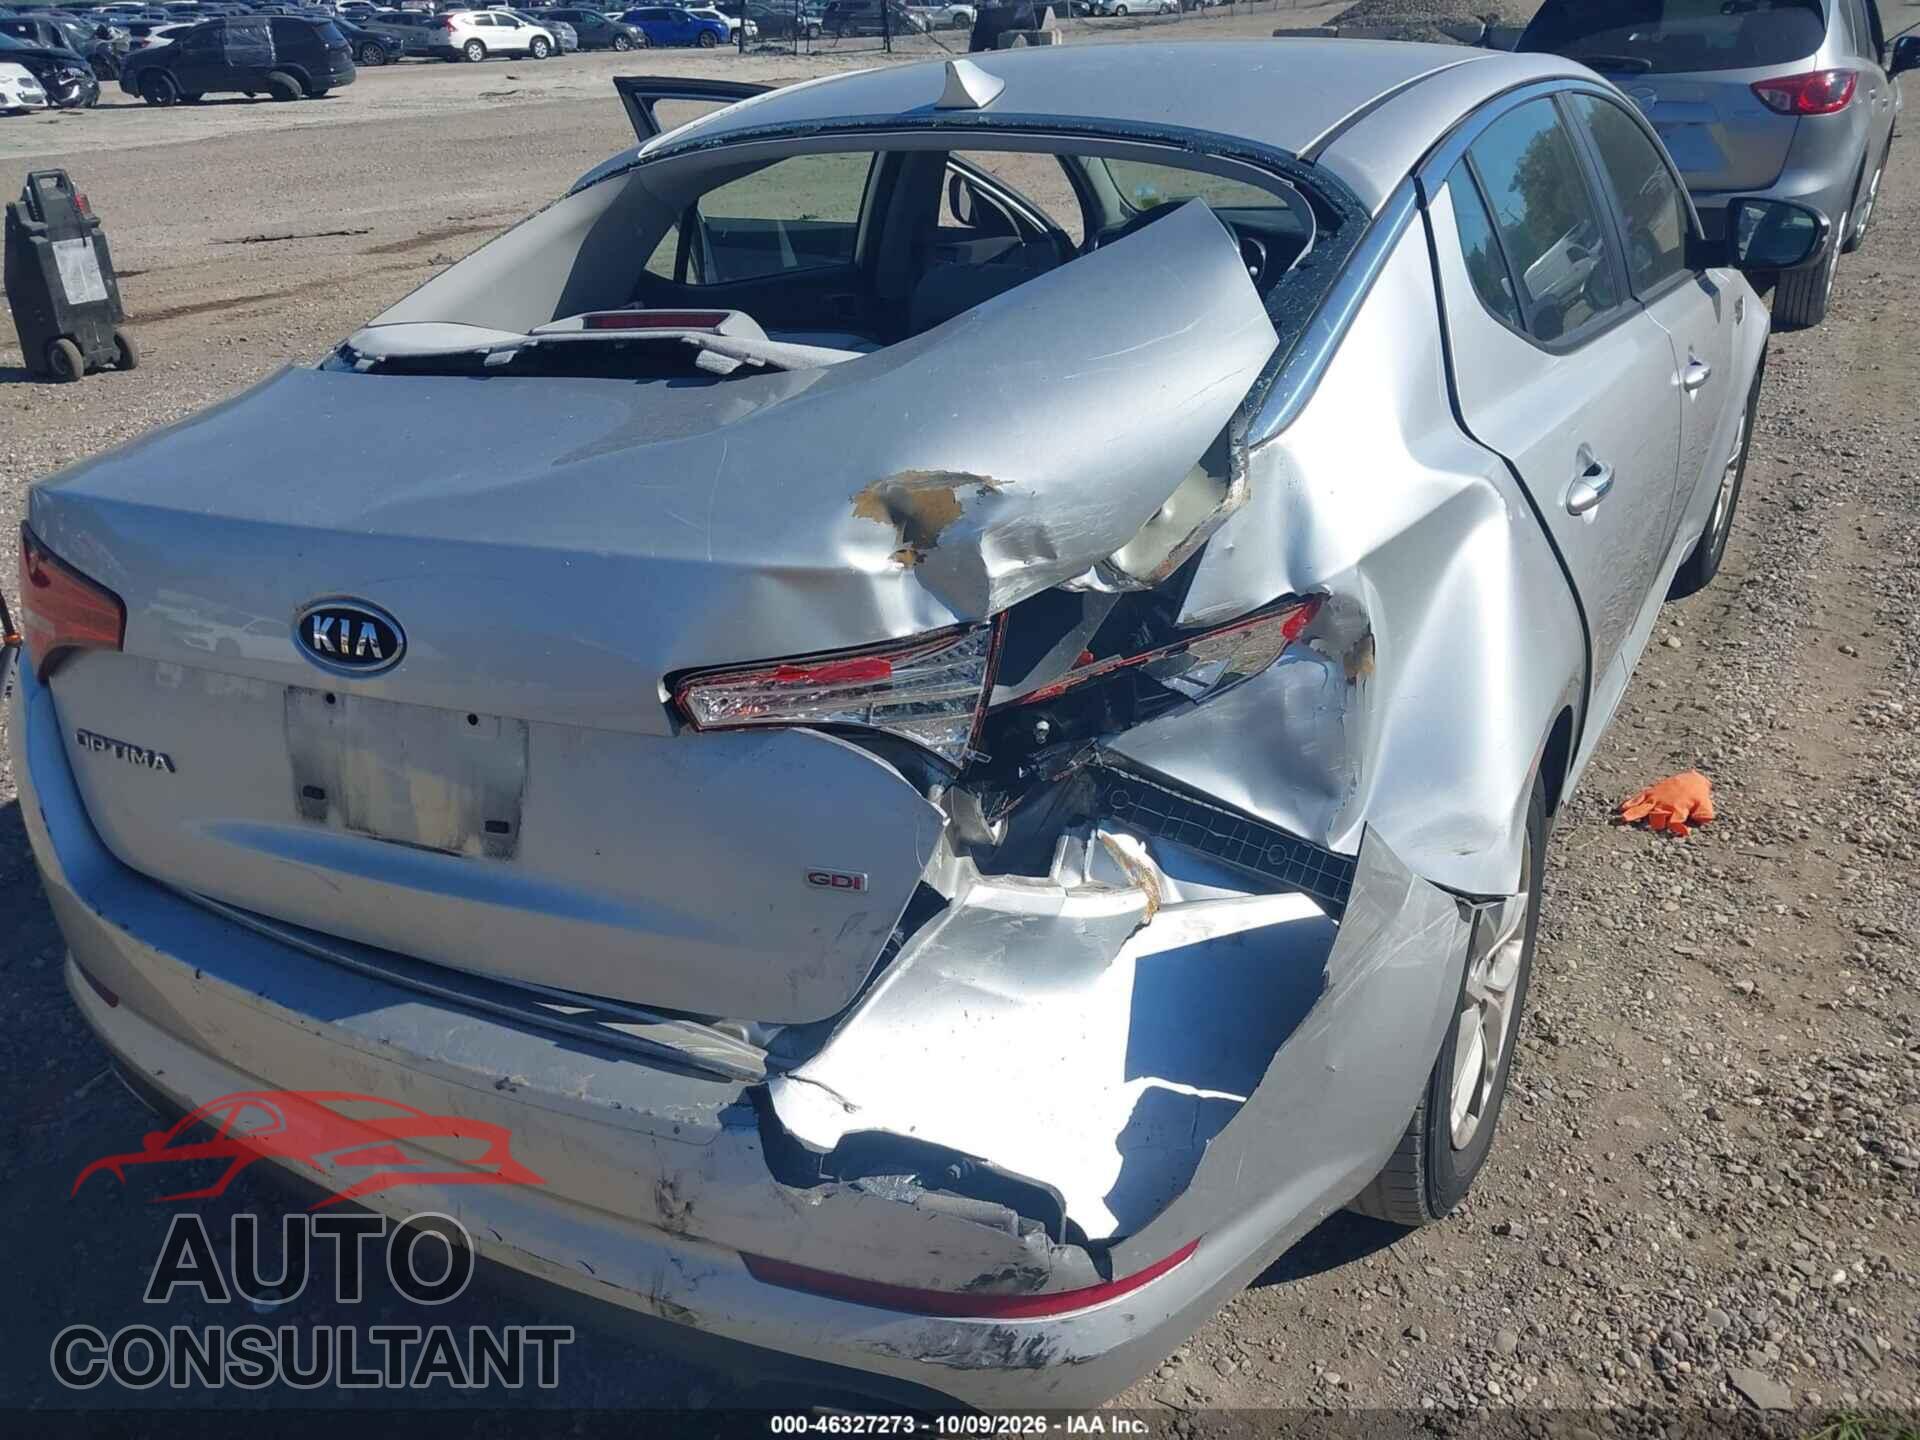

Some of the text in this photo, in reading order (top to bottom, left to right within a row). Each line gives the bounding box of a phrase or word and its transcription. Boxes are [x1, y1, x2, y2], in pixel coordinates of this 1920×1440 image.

[312, 615, 383, 659] KIA
[75, 728, 175, 773] OPTIMA
[808, 872, 861, 890] GDI
